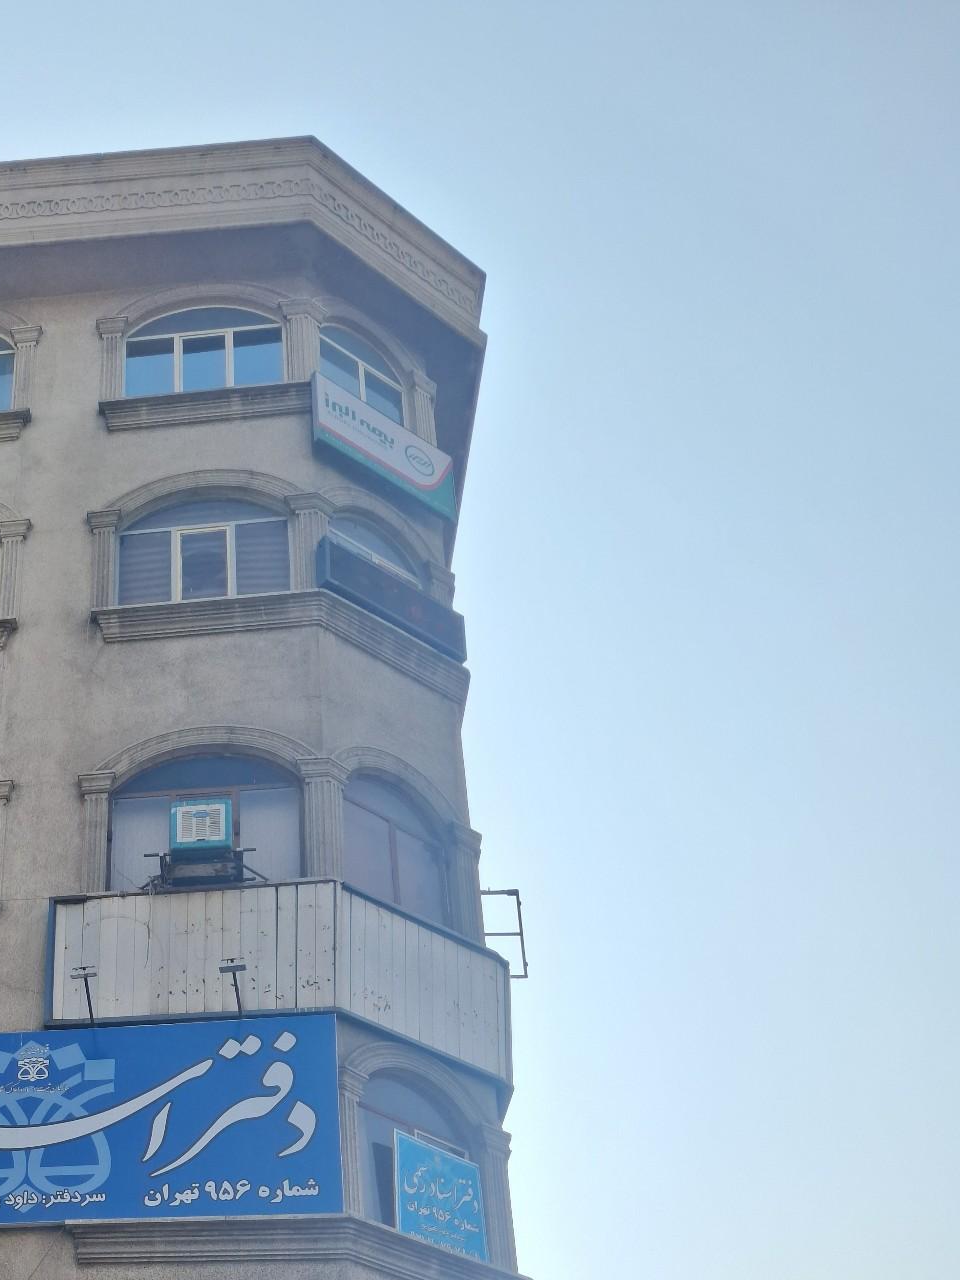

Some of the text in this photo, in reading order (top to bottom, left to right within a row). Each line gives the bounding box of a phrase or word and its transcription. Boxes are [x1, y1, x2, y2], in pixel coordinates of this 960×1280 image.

[151, 1030, 316, 1176] دفتر
[4, 1190, 38, 1210] داود
[41, 1188, 106, 1208] سردفتر:
[143, 1177, 319, 1207] شماره ۹۵۶ تهران
